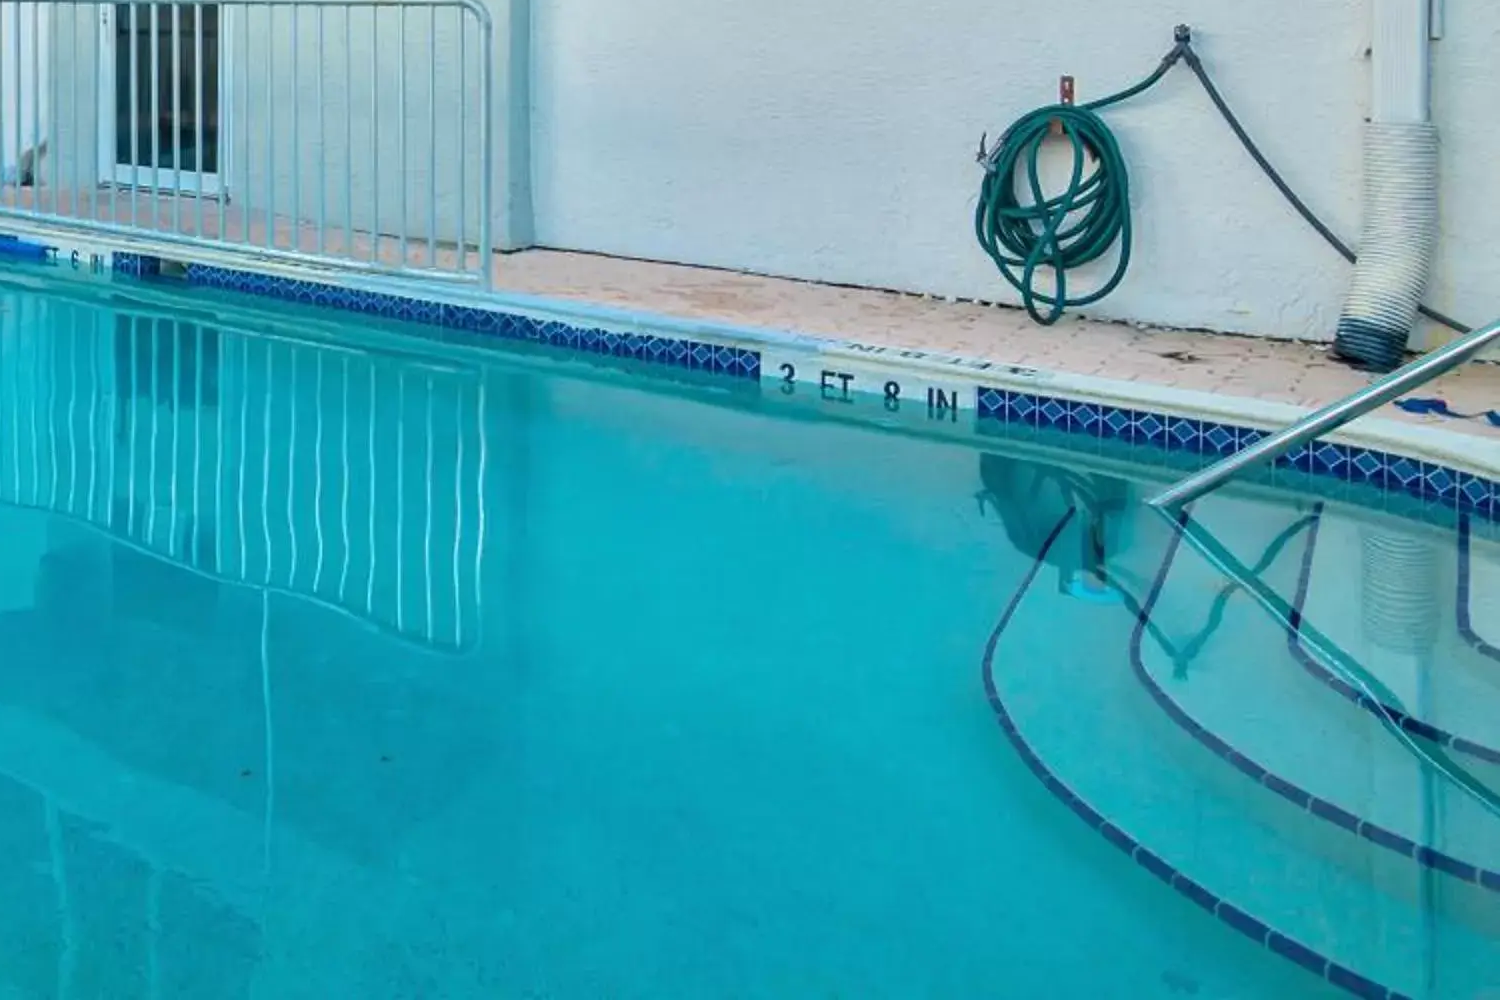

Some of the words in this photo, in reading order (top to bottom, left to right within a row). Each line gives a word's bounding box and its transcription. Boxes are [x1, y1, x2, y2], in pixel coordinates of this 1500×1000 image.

[821, 370, 854, 395] FT
[883, 381, 900, 402] 8
[927, 387, 957, 412] IN
